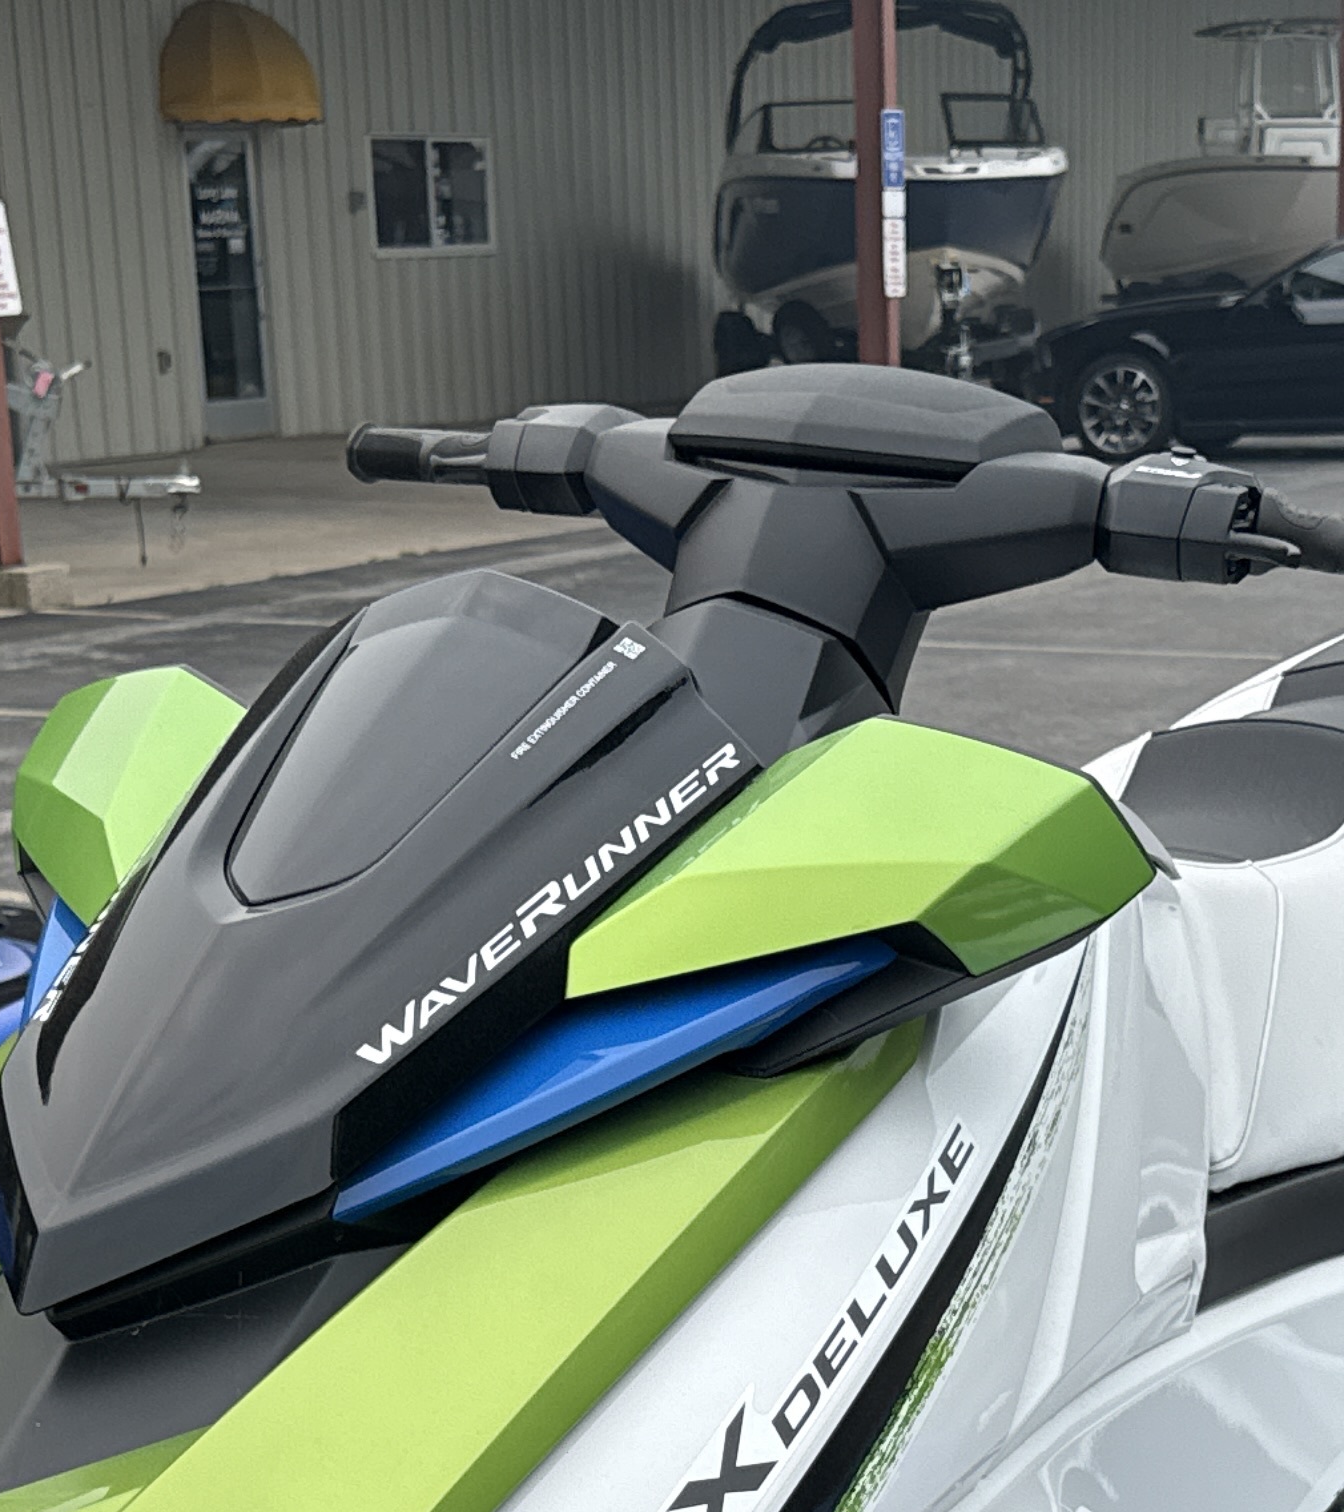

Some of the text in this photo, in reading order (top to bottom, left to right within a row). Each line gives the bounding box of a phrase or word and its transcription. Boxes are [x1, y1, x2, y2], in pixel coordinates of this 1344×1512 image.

[510, 660, 618, 760] FIRE EXTINGUISHER CONTAINER
[771, 1121, 977, 1450] DELUXE
